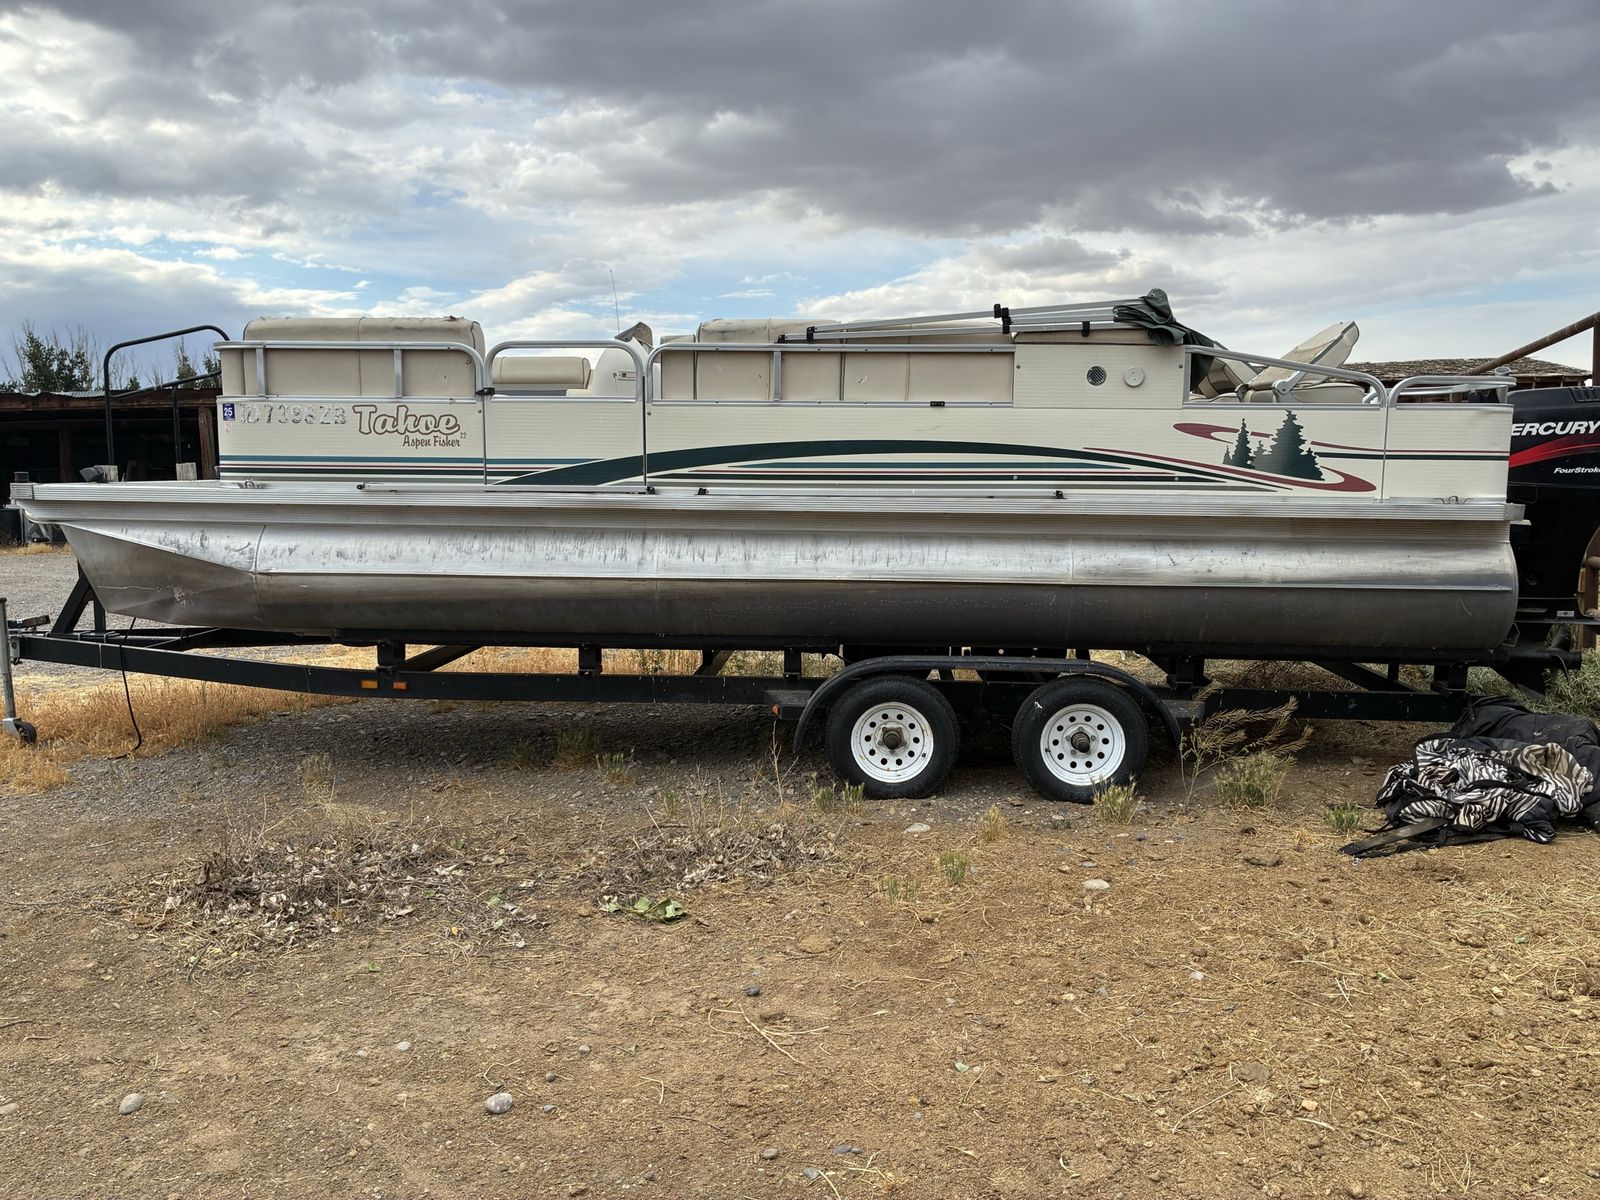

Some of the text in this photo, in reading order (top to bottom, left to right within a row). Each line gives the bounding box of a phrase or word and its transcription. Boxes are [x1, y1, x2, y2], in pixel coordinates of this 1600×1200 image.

[223, 407, 233, 417] 25
[351, 404, 461, 436] Tahoe
[1510, 420, 1600, 437] ERCURY
[402, 435, 461, 449] Aspen Fisher
[1553, 466, 1600, 474] FourStrok
